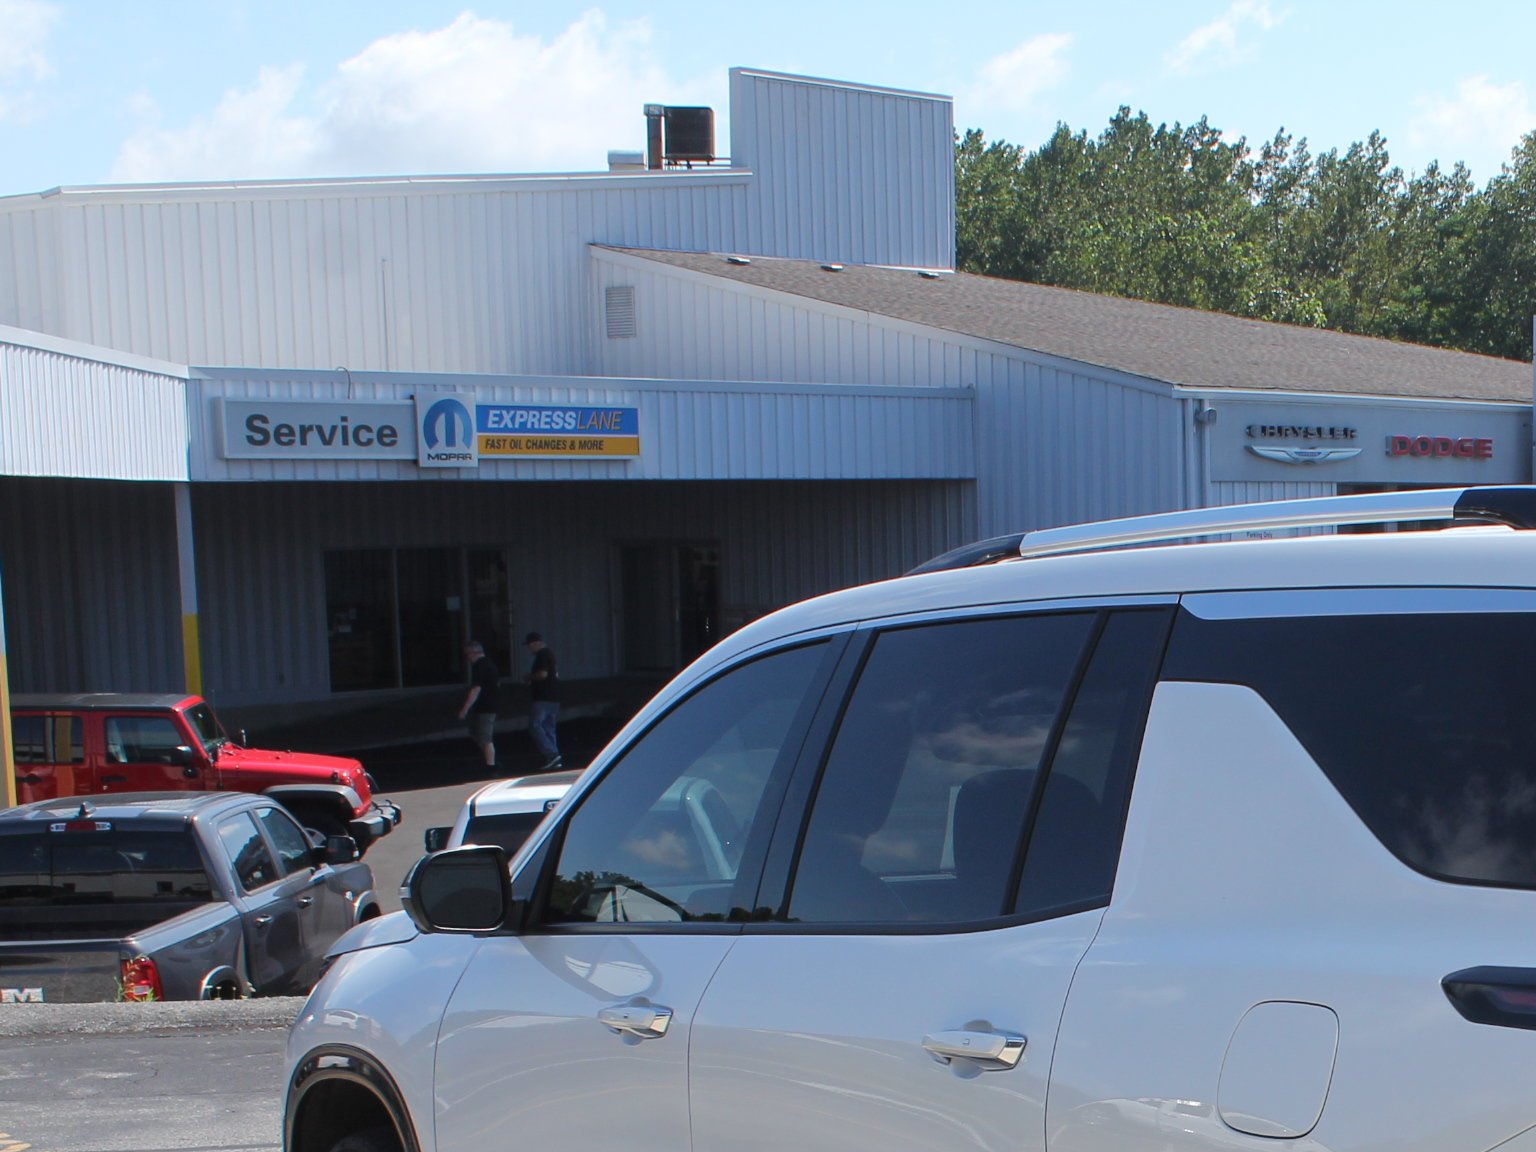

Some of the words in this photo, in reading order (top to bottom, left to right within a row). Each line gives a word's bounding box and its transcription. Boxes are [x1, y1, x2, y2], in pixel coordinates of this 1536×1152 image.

[487, 410, 623, 430] EXPRESSLANE
[245, 414, 398, 447] Service
[1246, 425, 1357, 439] CHRYSLER
[485, 438, 507, 450] FAST
[509, 439, 523, 450] OIL
[525, 440, 568, 450] CHANGES
[569, 440, 576, 450] &
[578, 440, 604, 451] MORE
[1387, 436, 1493, 458] DODGE
[427, 452, 473, 461] MOPAR
